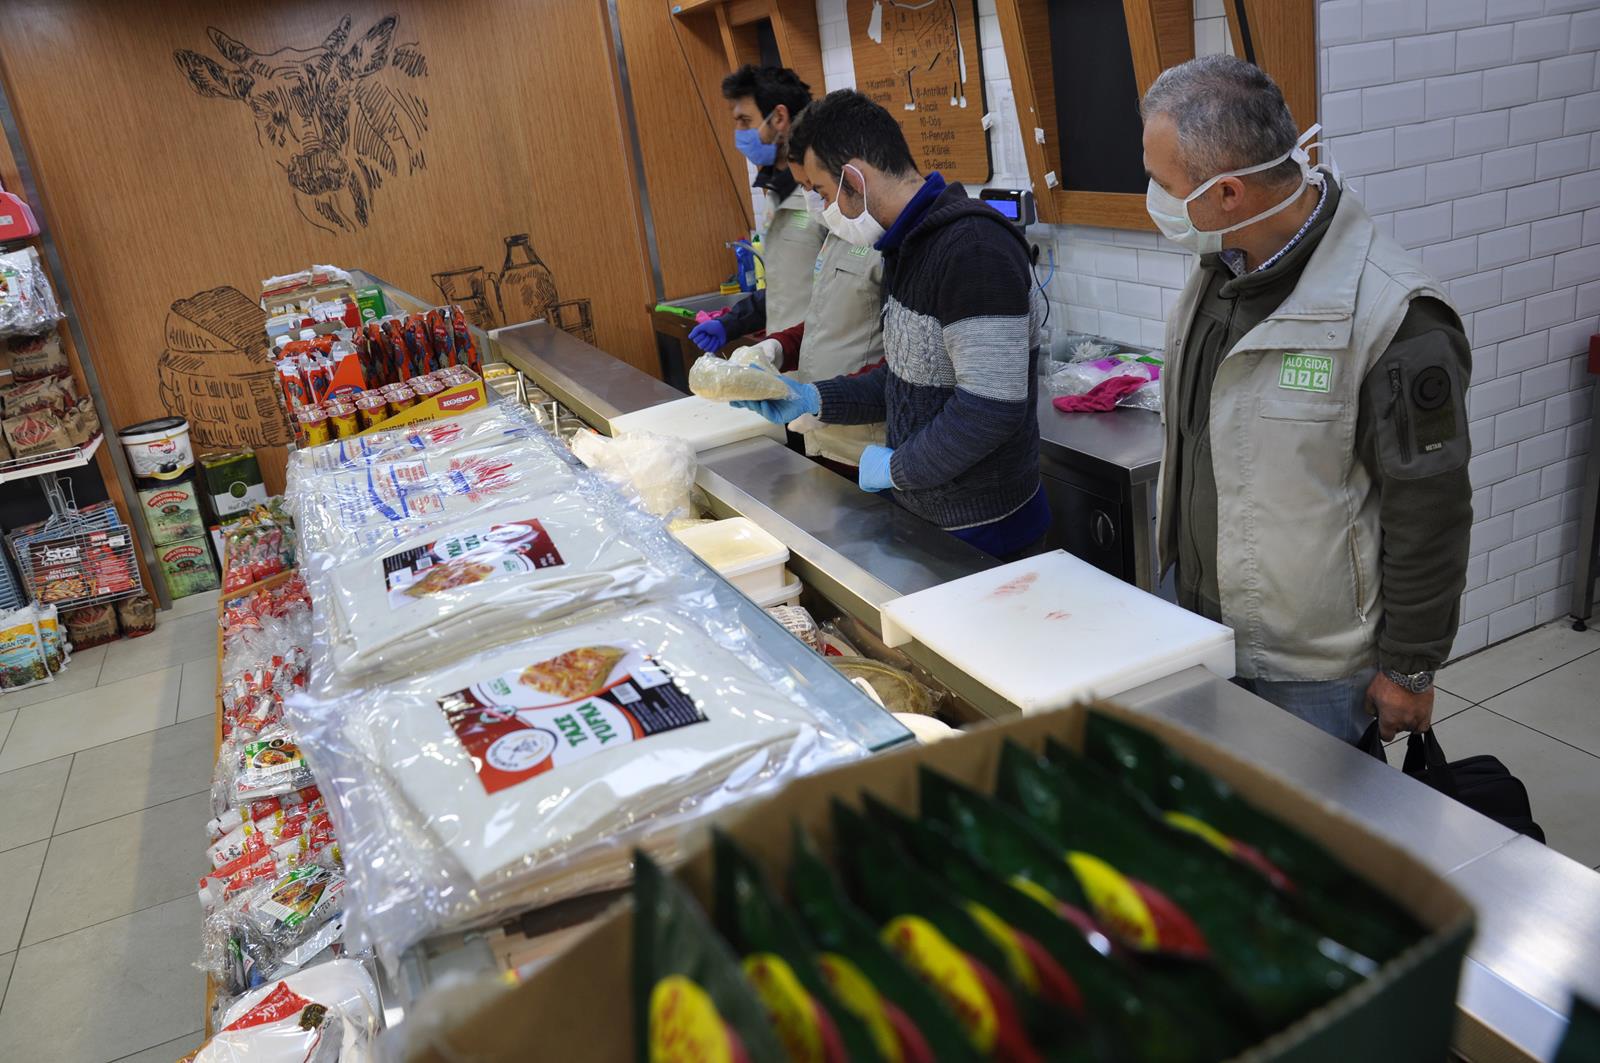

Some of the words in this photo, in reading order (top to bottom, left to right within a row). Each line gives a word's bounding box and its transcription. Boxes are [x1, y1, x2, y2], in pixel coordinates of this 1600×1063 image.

[1304, 358, 1328, 370] GIDA
[442, 394, 476, 407] KOSKA
[46, 546, 81, 561] star
[576, 701, 618, 745] YUFKA
[553, 713, 588, 749] TAZE
